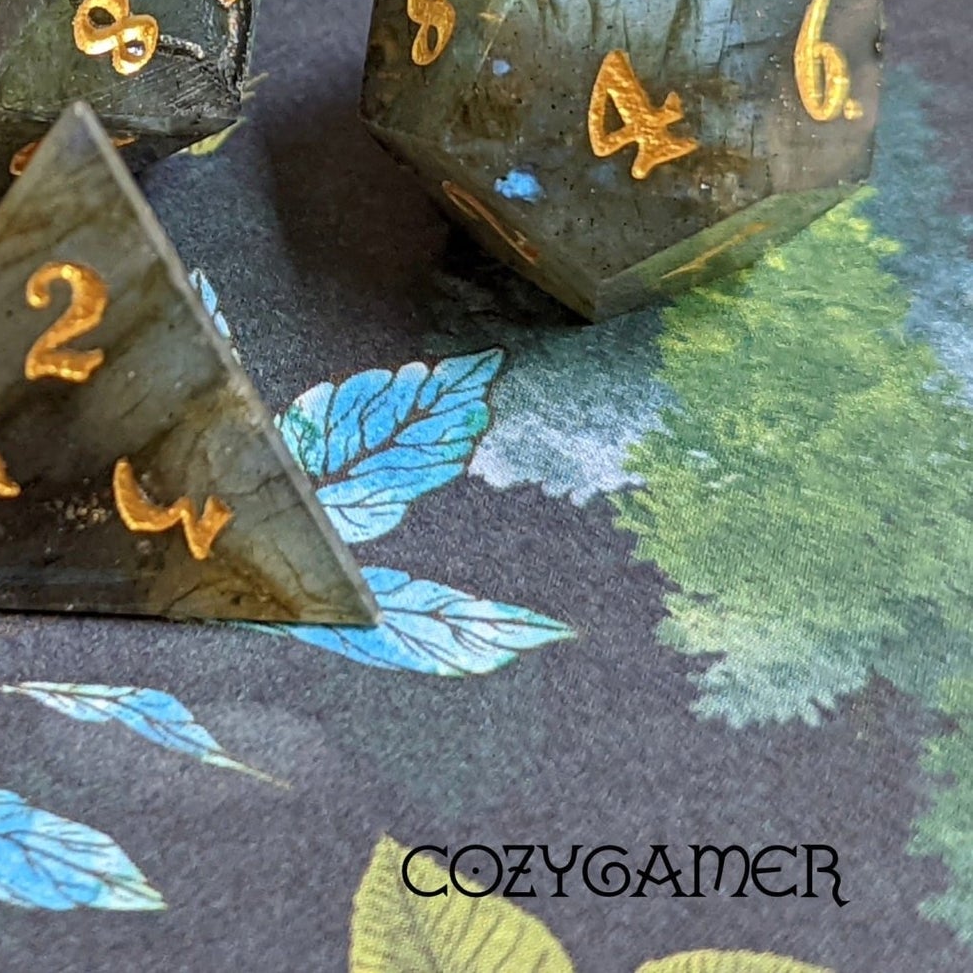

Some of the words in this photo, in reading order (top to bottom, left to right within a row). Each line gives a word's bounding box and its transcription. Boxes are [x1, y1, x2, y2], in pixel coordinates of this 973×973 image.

[588, 49, 700, 180] 4
[25, 260, 109, 381] 2
[112, 457, 235, 560] 3
